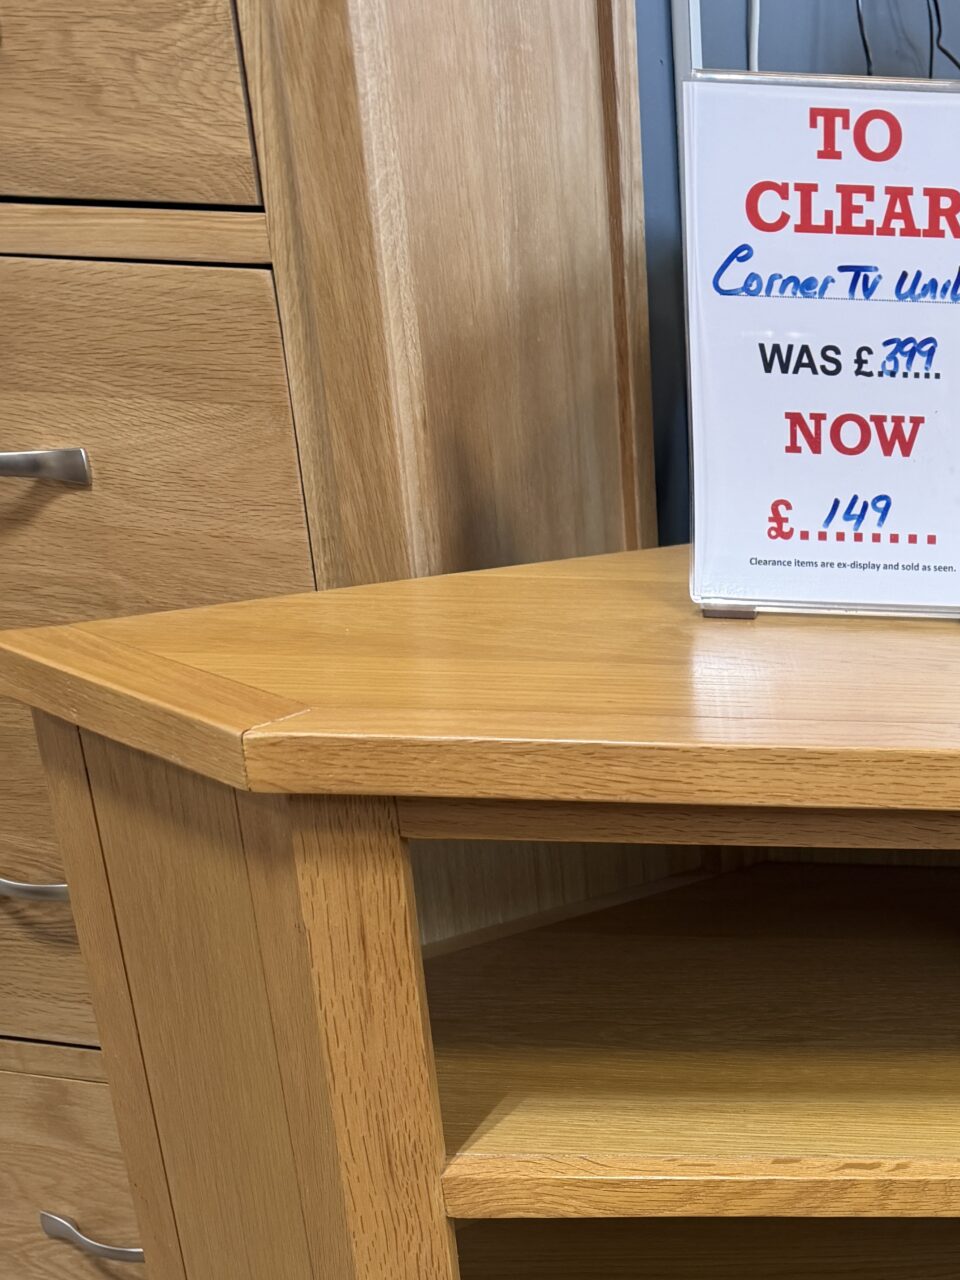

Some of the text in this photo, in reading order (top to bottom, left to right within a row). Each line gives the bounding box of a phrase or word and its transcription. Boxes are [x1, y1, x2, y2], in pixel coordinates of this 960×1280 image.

[809, 107, 902, 162] TO
[712, 243, 836, 299] Corner
[758, 342, 842, 376] WAS
[784, 411, 925, 457] NOW
[749, 557, 957, 573] Clearance items are ex-display and sold as seen.
